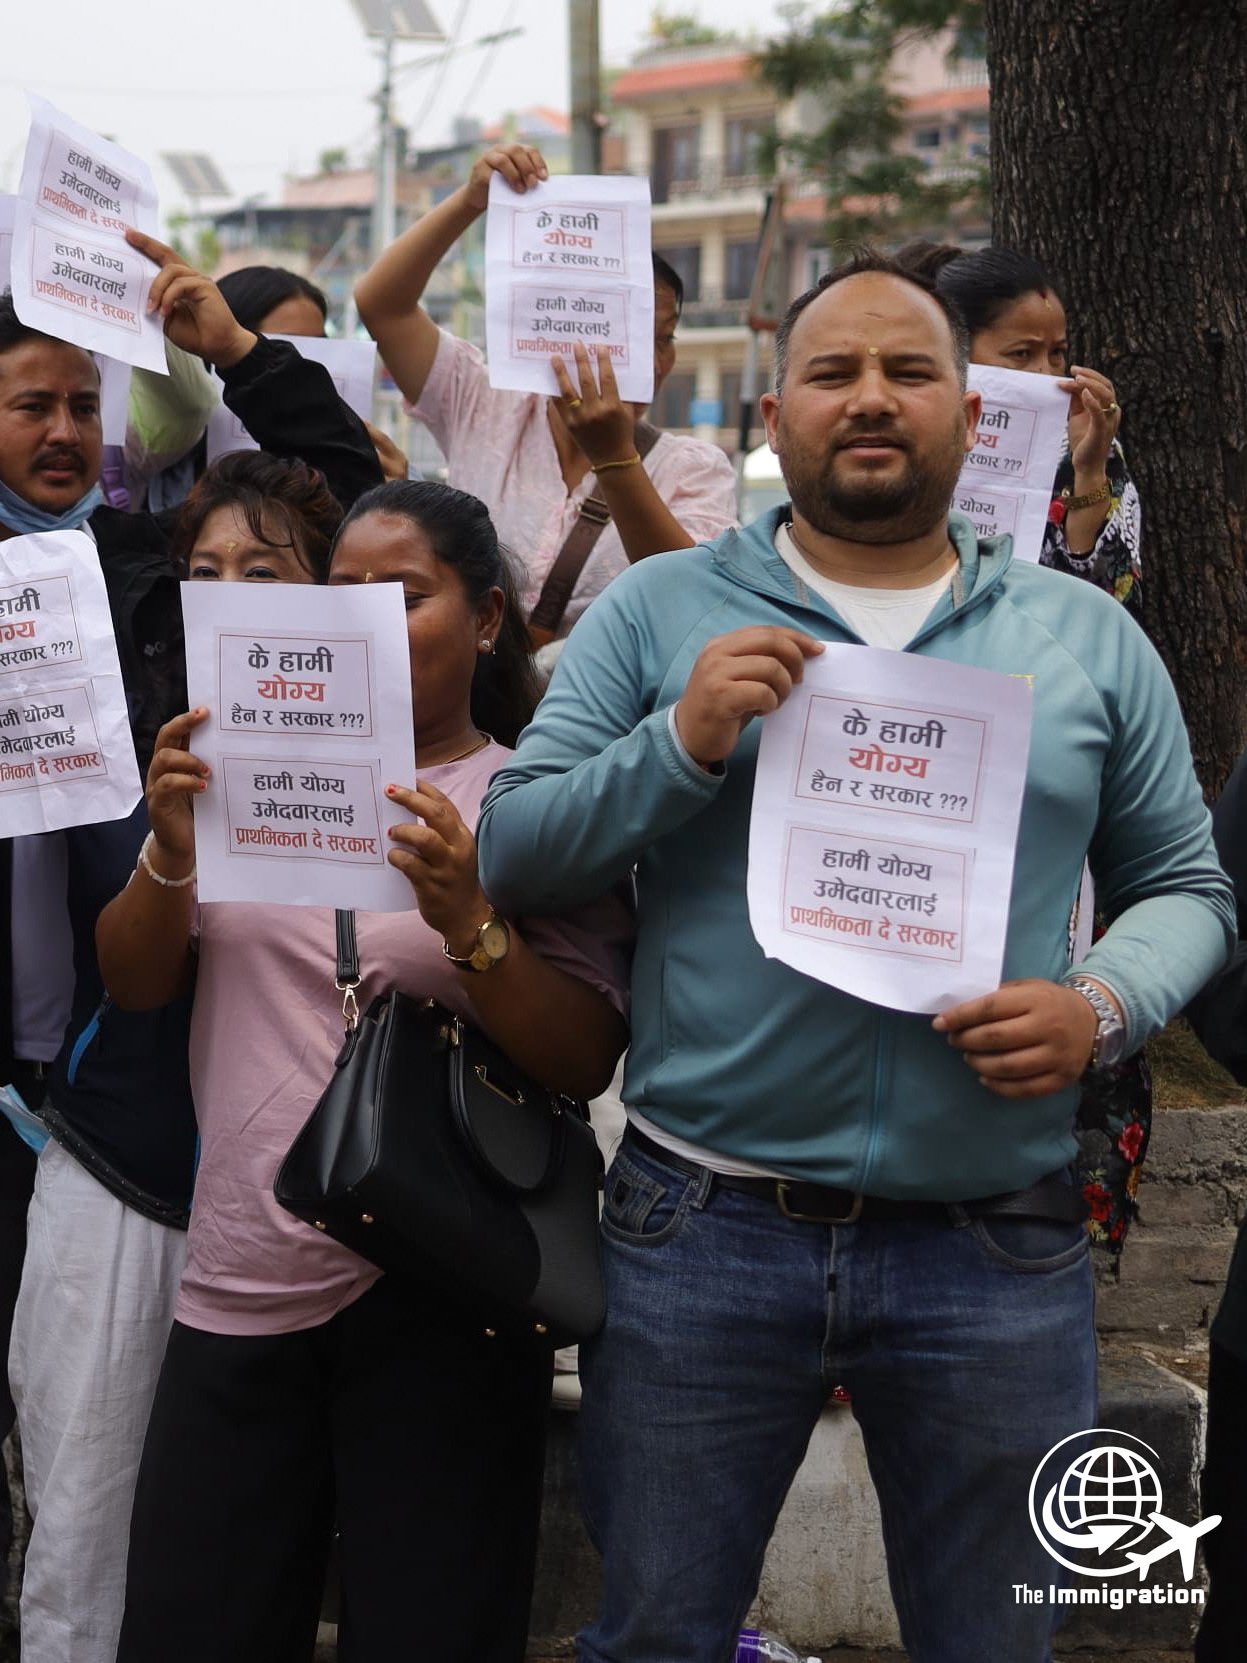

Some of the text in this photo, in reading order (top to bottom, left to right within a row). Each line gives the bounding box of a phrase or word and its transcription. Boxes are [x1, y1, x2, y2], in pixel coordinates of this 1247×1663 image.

[68, 149, 122, 192] हामी योग्य
[59, 170, 121, 214] उमेदवारलाई
[90, 209, 98, 224] दे
[55, 242, 124, 272] हामी योग्य
[52, 261, 127, 300] उमेदवारलाई
[36, 280, 137, 325] प्राथमिकता दे सरकार
[1004, 458, 1022, 471] ???
[960, 497, 995, 515] योग्य
[0, 646, 48, 667] सरकार
[51, 641, 74, 656] ???
[248, 643, 334, 673] के हामी
[257, 674, 326, 702] योग्य
[23, 703, 65, 723] योग्य
[231, 703, 364, 729] हैन र सरकार ???
[842, 708, 947, 749] के हामी
[39, 756, 50, 775] दे
[53, 751, 100, 773] सरकार
[848, 744, 930, 779] योग्य
[253, 770, 345, 795] हामी योग्य
[810, 769, 968, 812] हैन र सरकार ???
[252, 798, 354, 827] उमेदवारलाई
[236, 825, 377, 854] प्राथमिकता दे सरकार
[822, 848, 933, 881] हामी योग्य
[813, 877, 938, 917] उमेदवारलाई
[790, 905, 958, 950] प्राथमिकता दे सरकार
